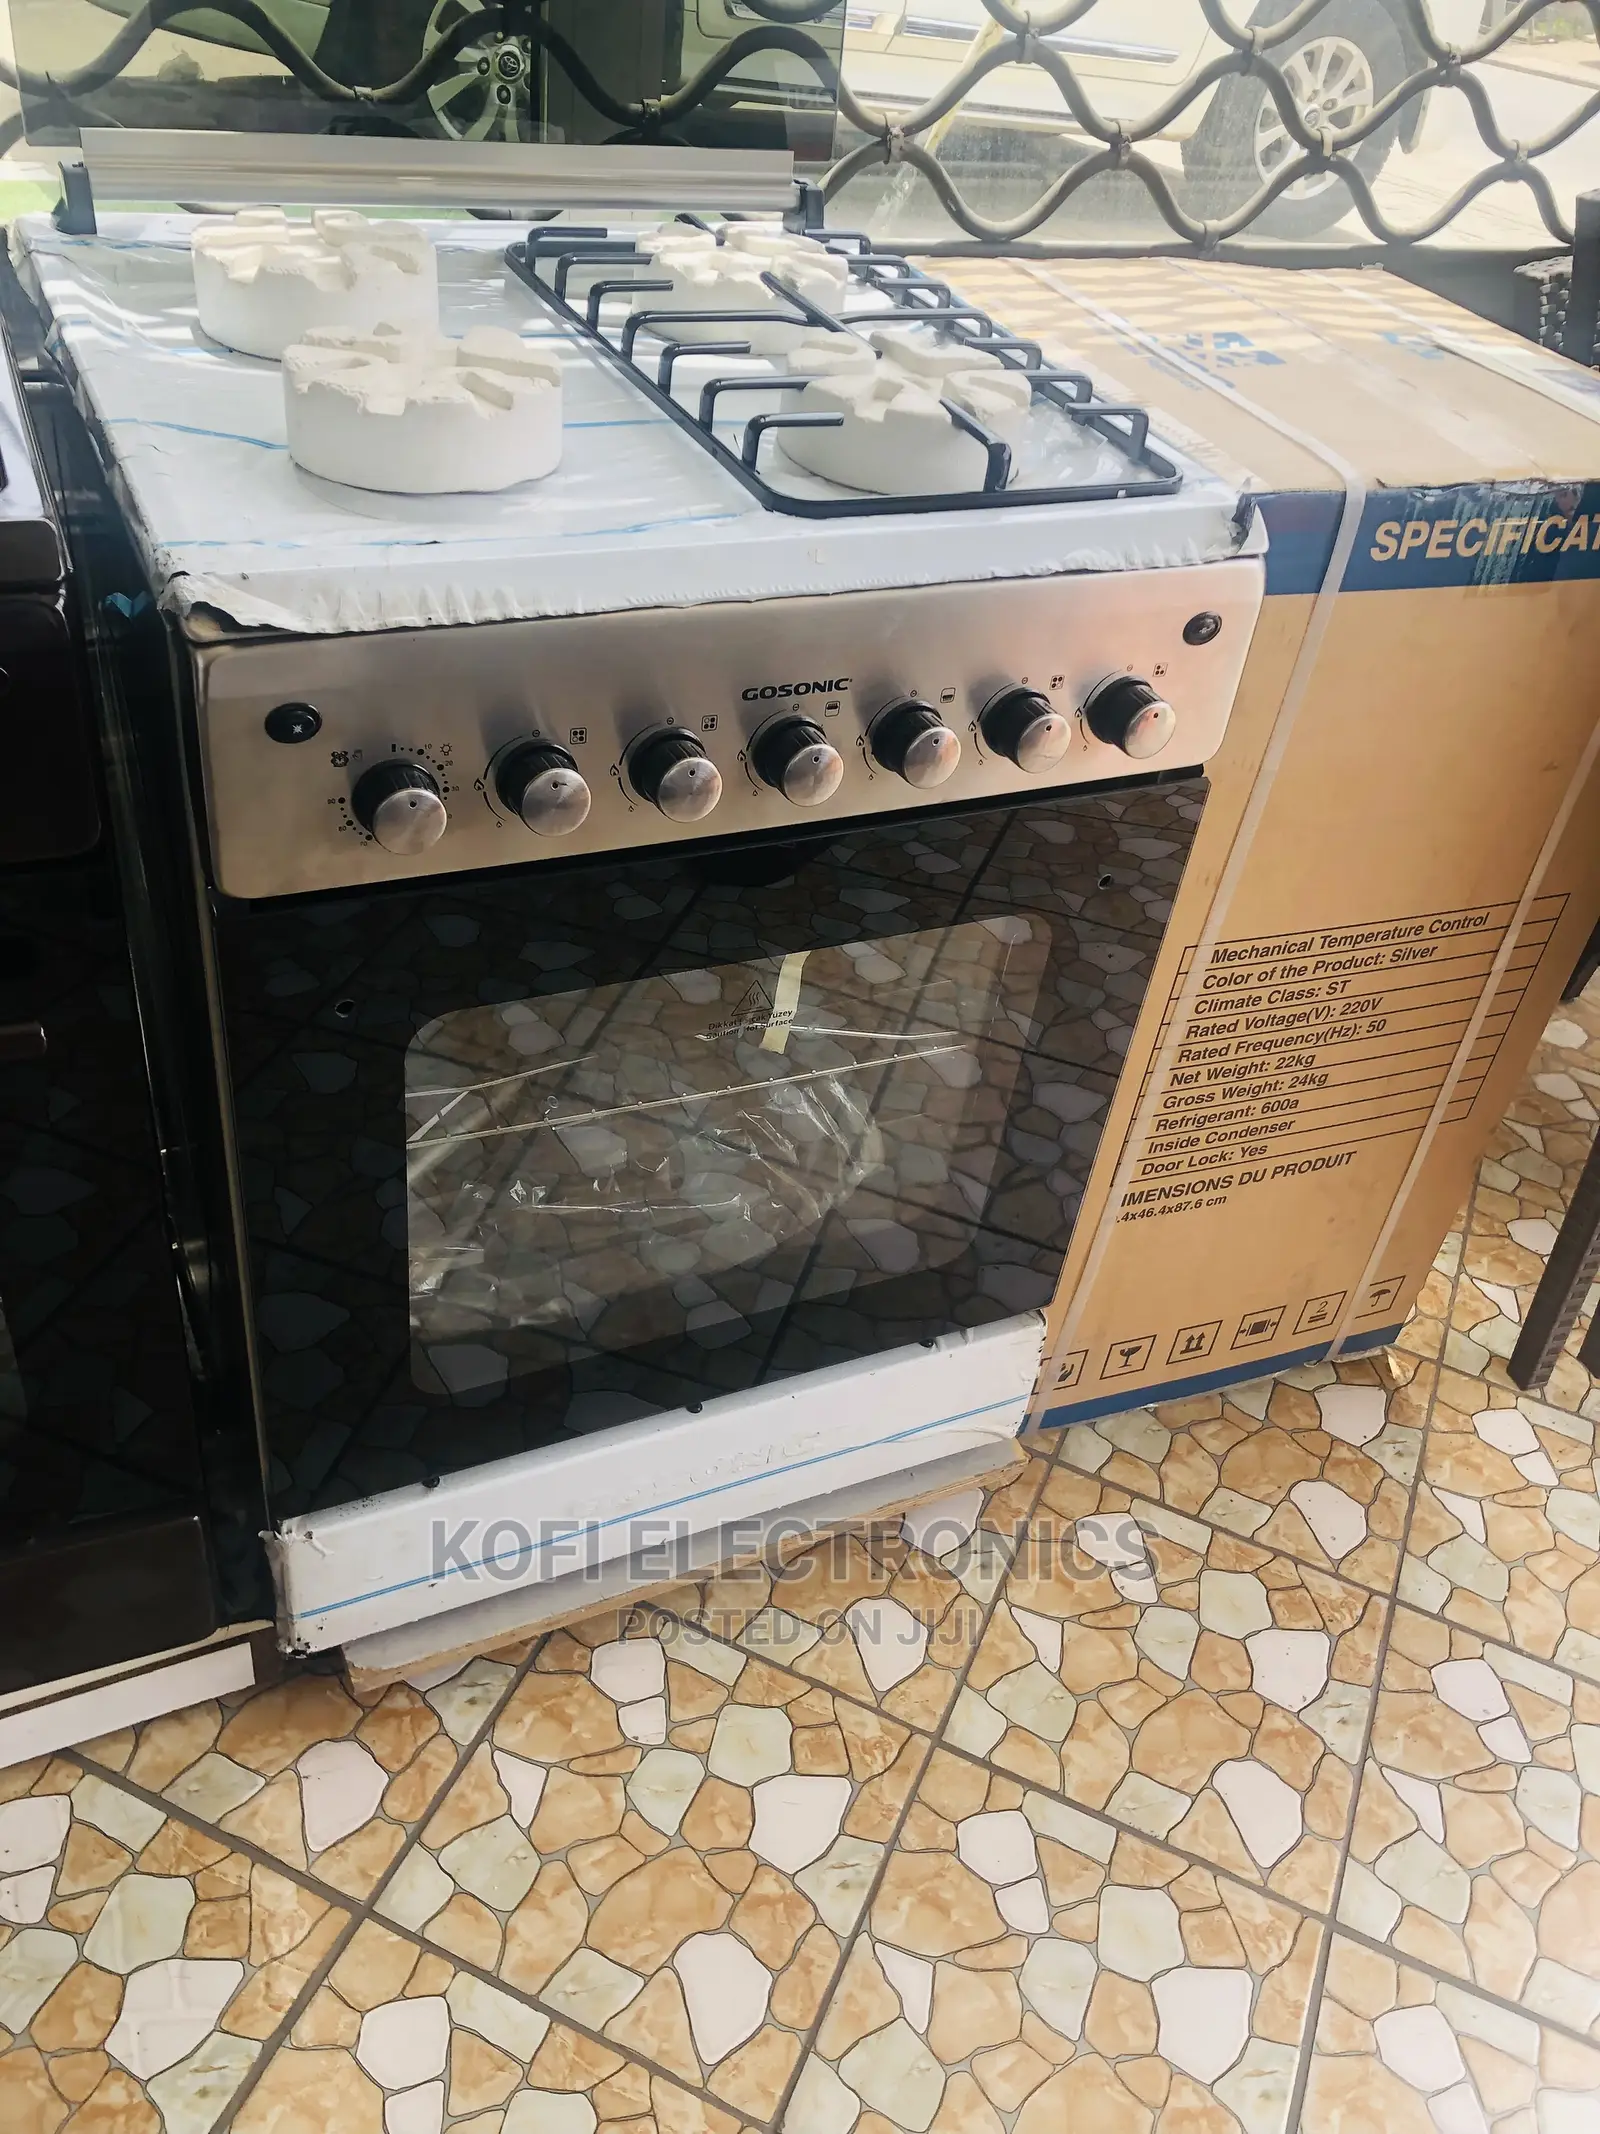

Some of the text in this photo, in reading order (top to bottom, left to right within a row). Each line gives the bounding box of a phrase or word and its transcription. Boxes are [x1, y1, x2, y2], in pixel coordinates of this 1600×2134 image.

[1370, 514, 1600, 562] SPECIFICA
[741, 678, 850, 701] GOSONIC
[1211, 912, 1490, 964] Mechanical Temperature Control
[1203, 946, 1439, 990] Color of the Product: Silver
[1194, 980, 1352, 1015] Climate Class: ST
[1185, 997, 1383, 1039] Rated Voltage(V): 220V
[1177, 1019, 1387, 1063] Rated Frequency(Hz): 50
[1170, 1053, 1317, 1087] Net Weight: 22kg
[1163, 1072, 1330, 1110] Gross Weight: 24kg
[1155, 1098, 1300, 1132] Refrigerant: 600a
[1148, 1119, 1296, 1154] Inside Condenser
[1140, 1145, 1269, 1176] Door Lock: Yes
[1120, 1150, 1358, 1208] IMENSIONS DU PRODUIT
[1115, 1195, 1228, 1223] .4x46.4x87.6 cm
[1316, 1300, 1328, 1313] 2
